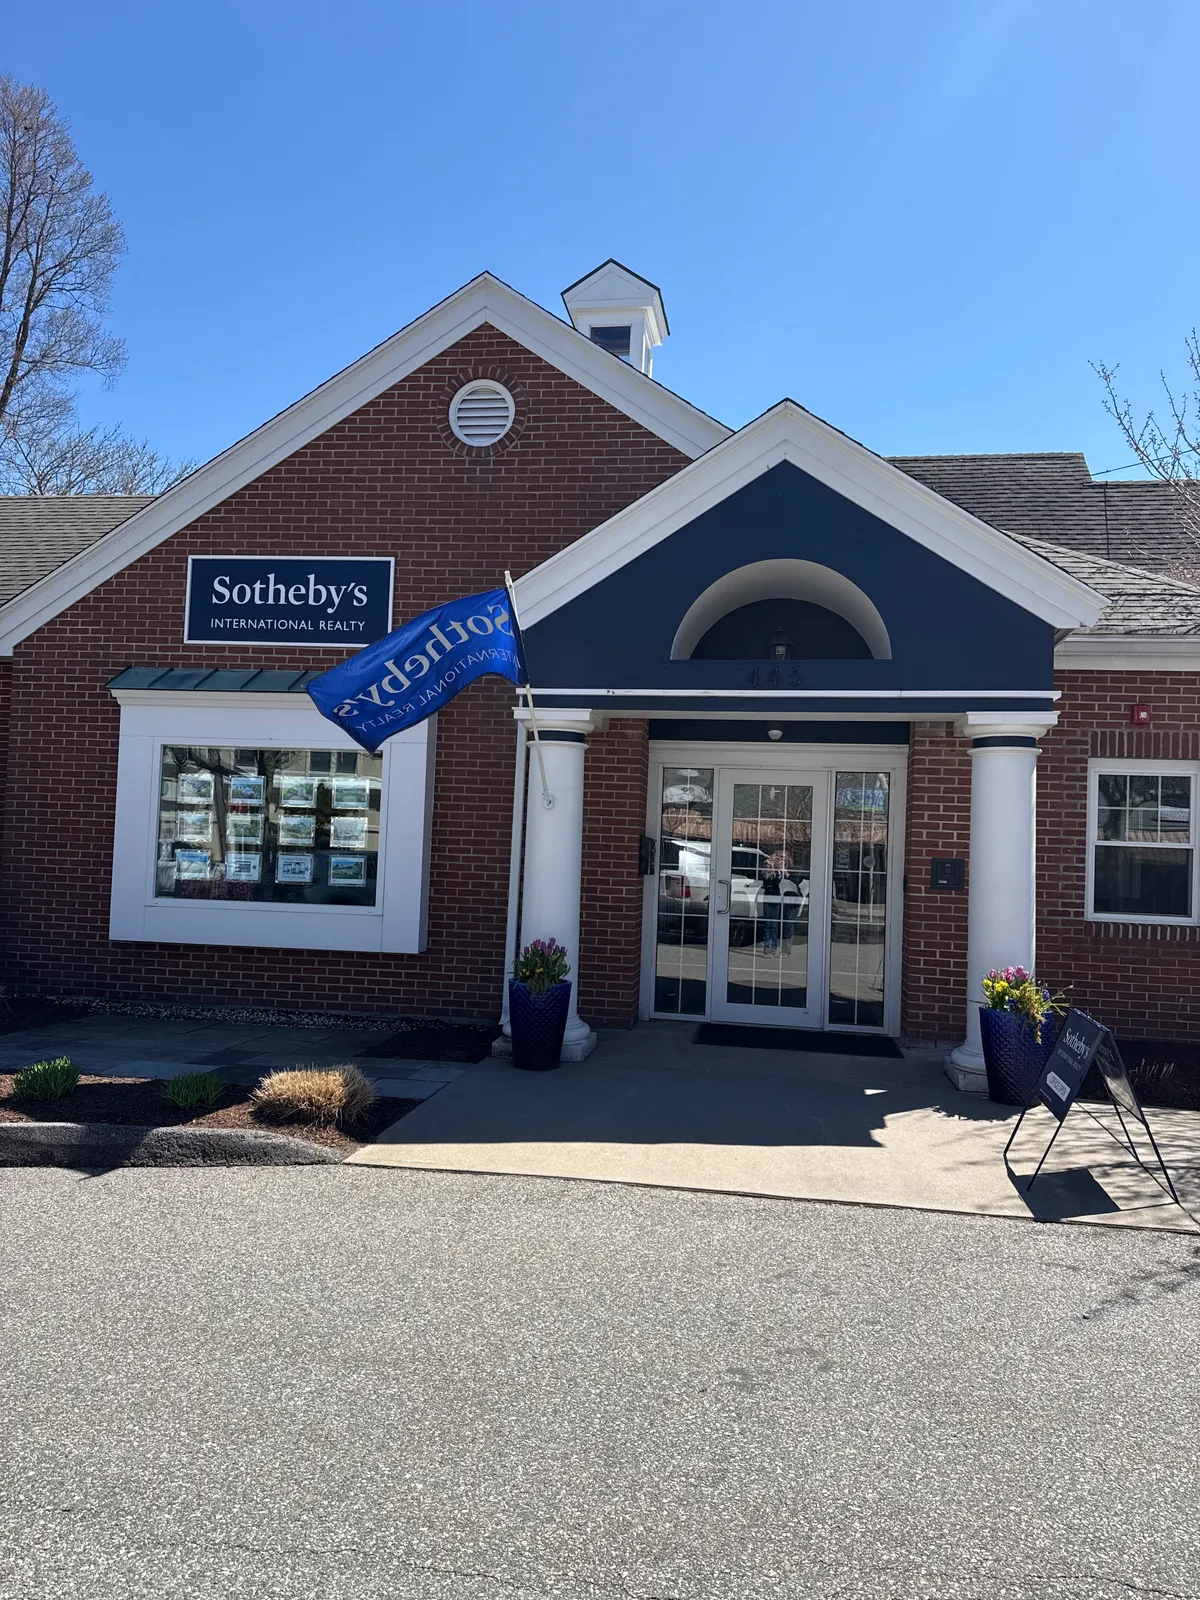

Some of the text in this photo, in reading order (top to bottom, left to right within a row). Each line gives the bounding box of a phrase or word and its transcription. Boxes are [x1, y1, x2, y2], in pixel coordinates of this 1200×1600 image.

[212, 573, 368, 614] Sotheby's
[210, 618, 366, 632] INTERNATIONAL REALTY
[747, 665, 803, 688] 445
[1063, 1028, 1090, 1059] Sotheby's
